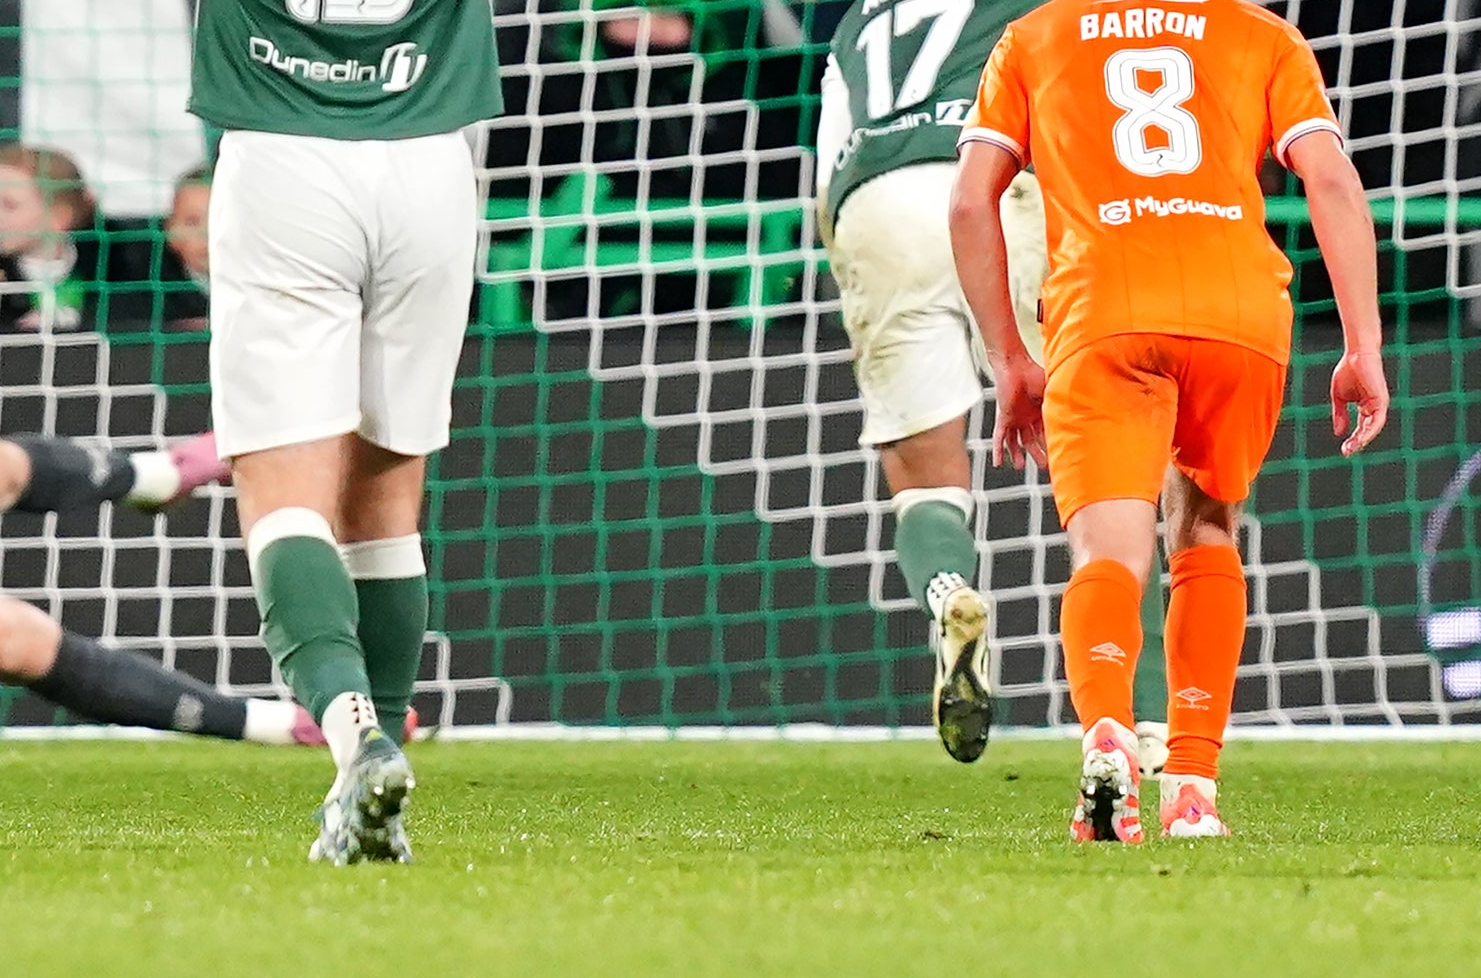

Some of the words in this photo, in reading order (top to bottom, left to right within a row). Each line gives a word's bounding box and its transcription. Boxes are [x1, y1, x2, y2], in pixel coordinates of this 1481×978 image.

[1080, 7, 1207, 41] BARRON
[249, 36, 377, 83] Dunedin
[1104, 46, 1202, 177] 8
[1134, 195, 1243, 221] MyGuava
